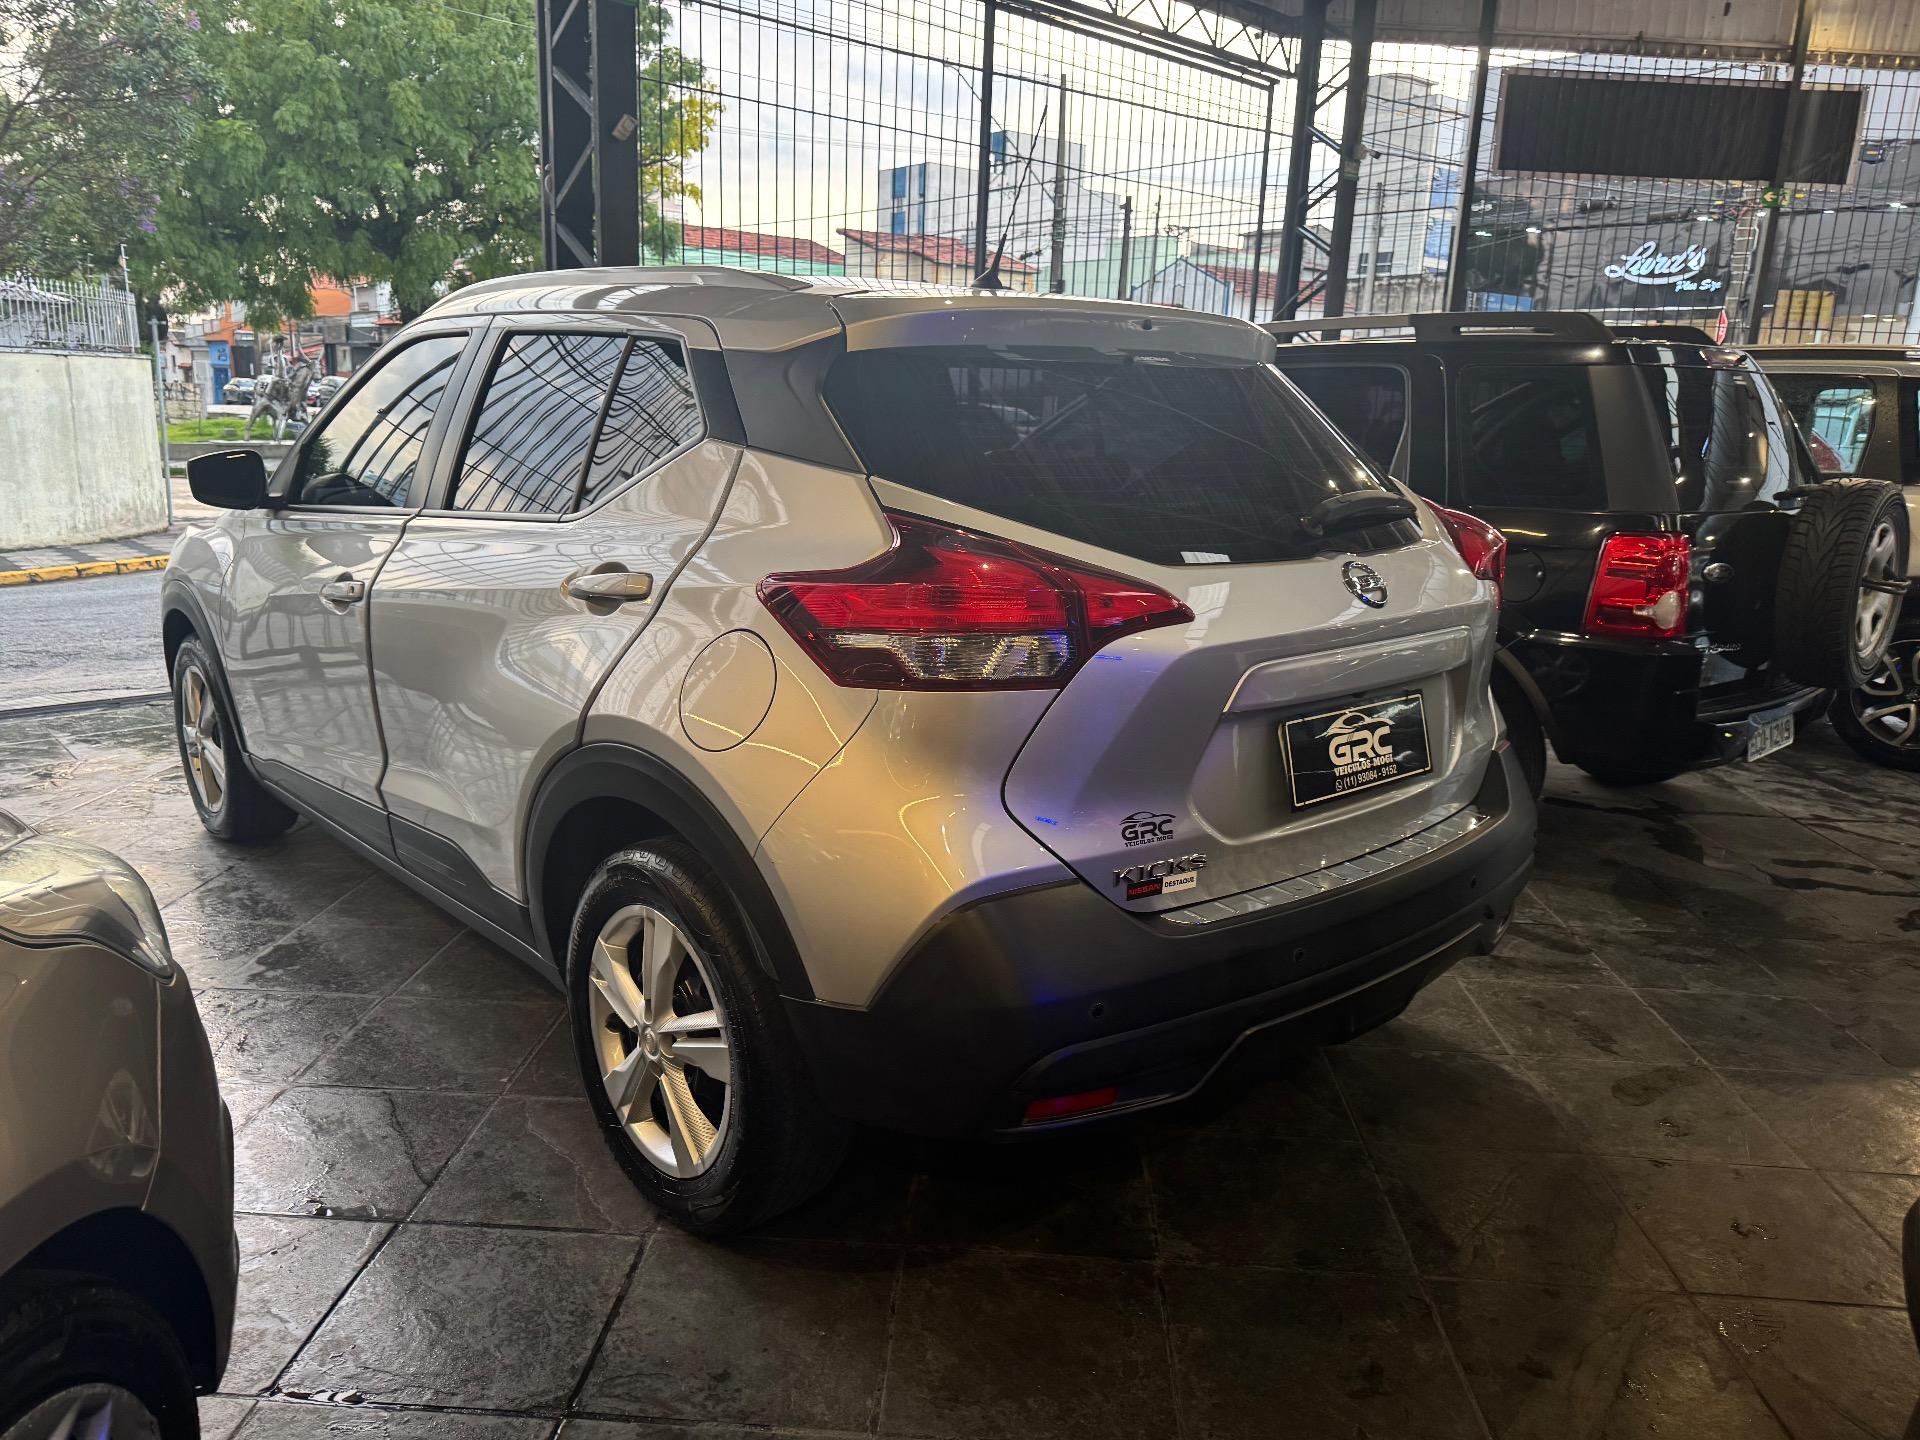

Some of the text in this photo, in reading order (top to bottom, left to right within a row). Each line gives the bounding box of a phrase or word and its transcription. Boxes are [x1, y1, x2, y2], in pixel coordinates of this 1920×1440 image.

[1329, 726, 1393, 766] GRC
[1121, 818, 1173, 841] GRC
[1112, 853, 1207, 888] KICKS
